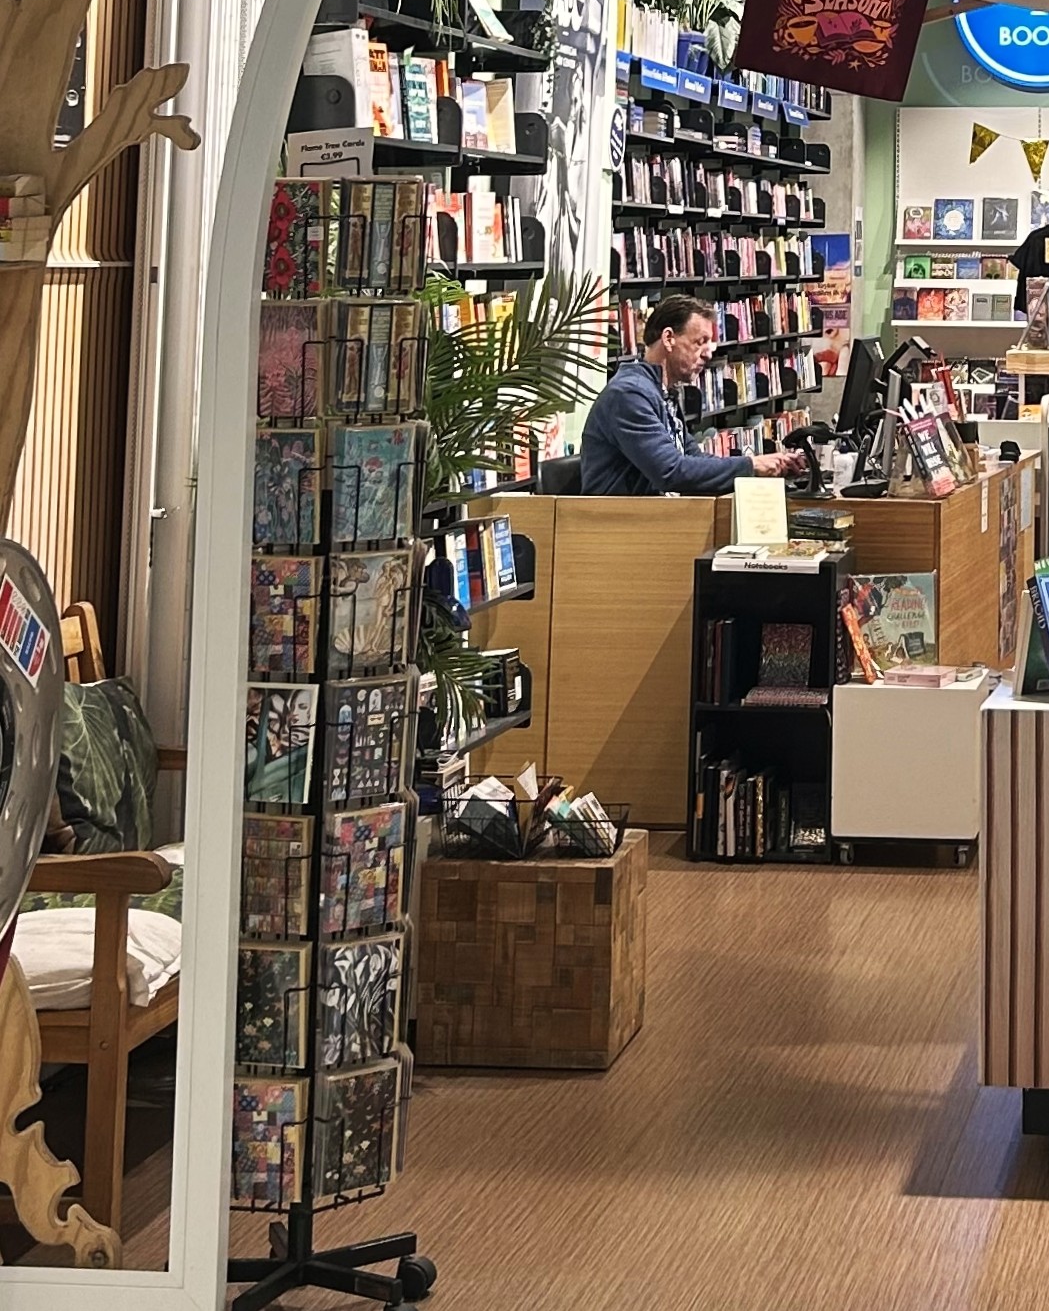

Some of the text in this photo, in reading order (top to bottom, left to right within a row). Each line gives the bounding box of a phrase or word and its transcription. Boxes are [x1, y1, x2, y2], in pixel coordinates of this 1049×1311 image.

[301, 144, 323, 152] Flame
[342, 139, 365, 147] Cards
[321, 151, 343, 160] €3.99
[744, 561, 788, 571] Notebooks
